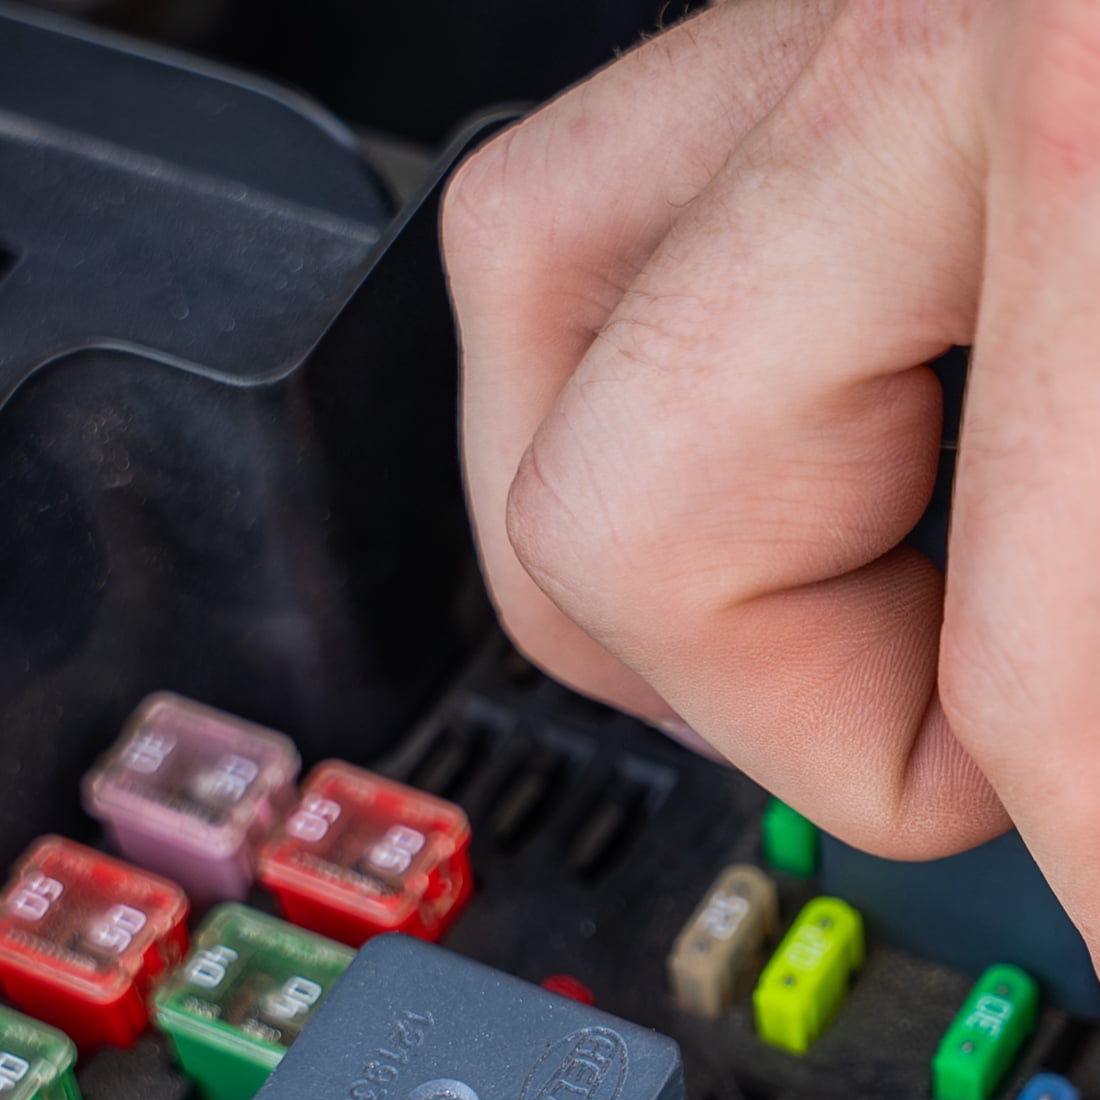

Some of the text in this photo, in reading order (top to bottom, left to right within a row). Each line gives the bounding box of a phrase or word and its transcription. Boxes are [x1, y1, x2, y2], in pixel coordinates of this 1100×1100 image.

[287, 796, 342, 843] 50
[369, 824, 425, 873] 50
[10, 872, 64, 921] 50
[92, 904, 147, 954] 50
[185, 945, 239, 988] 40
[262, 976, 323, 1020] 40
[965, 992, 1014, 1043] 30
